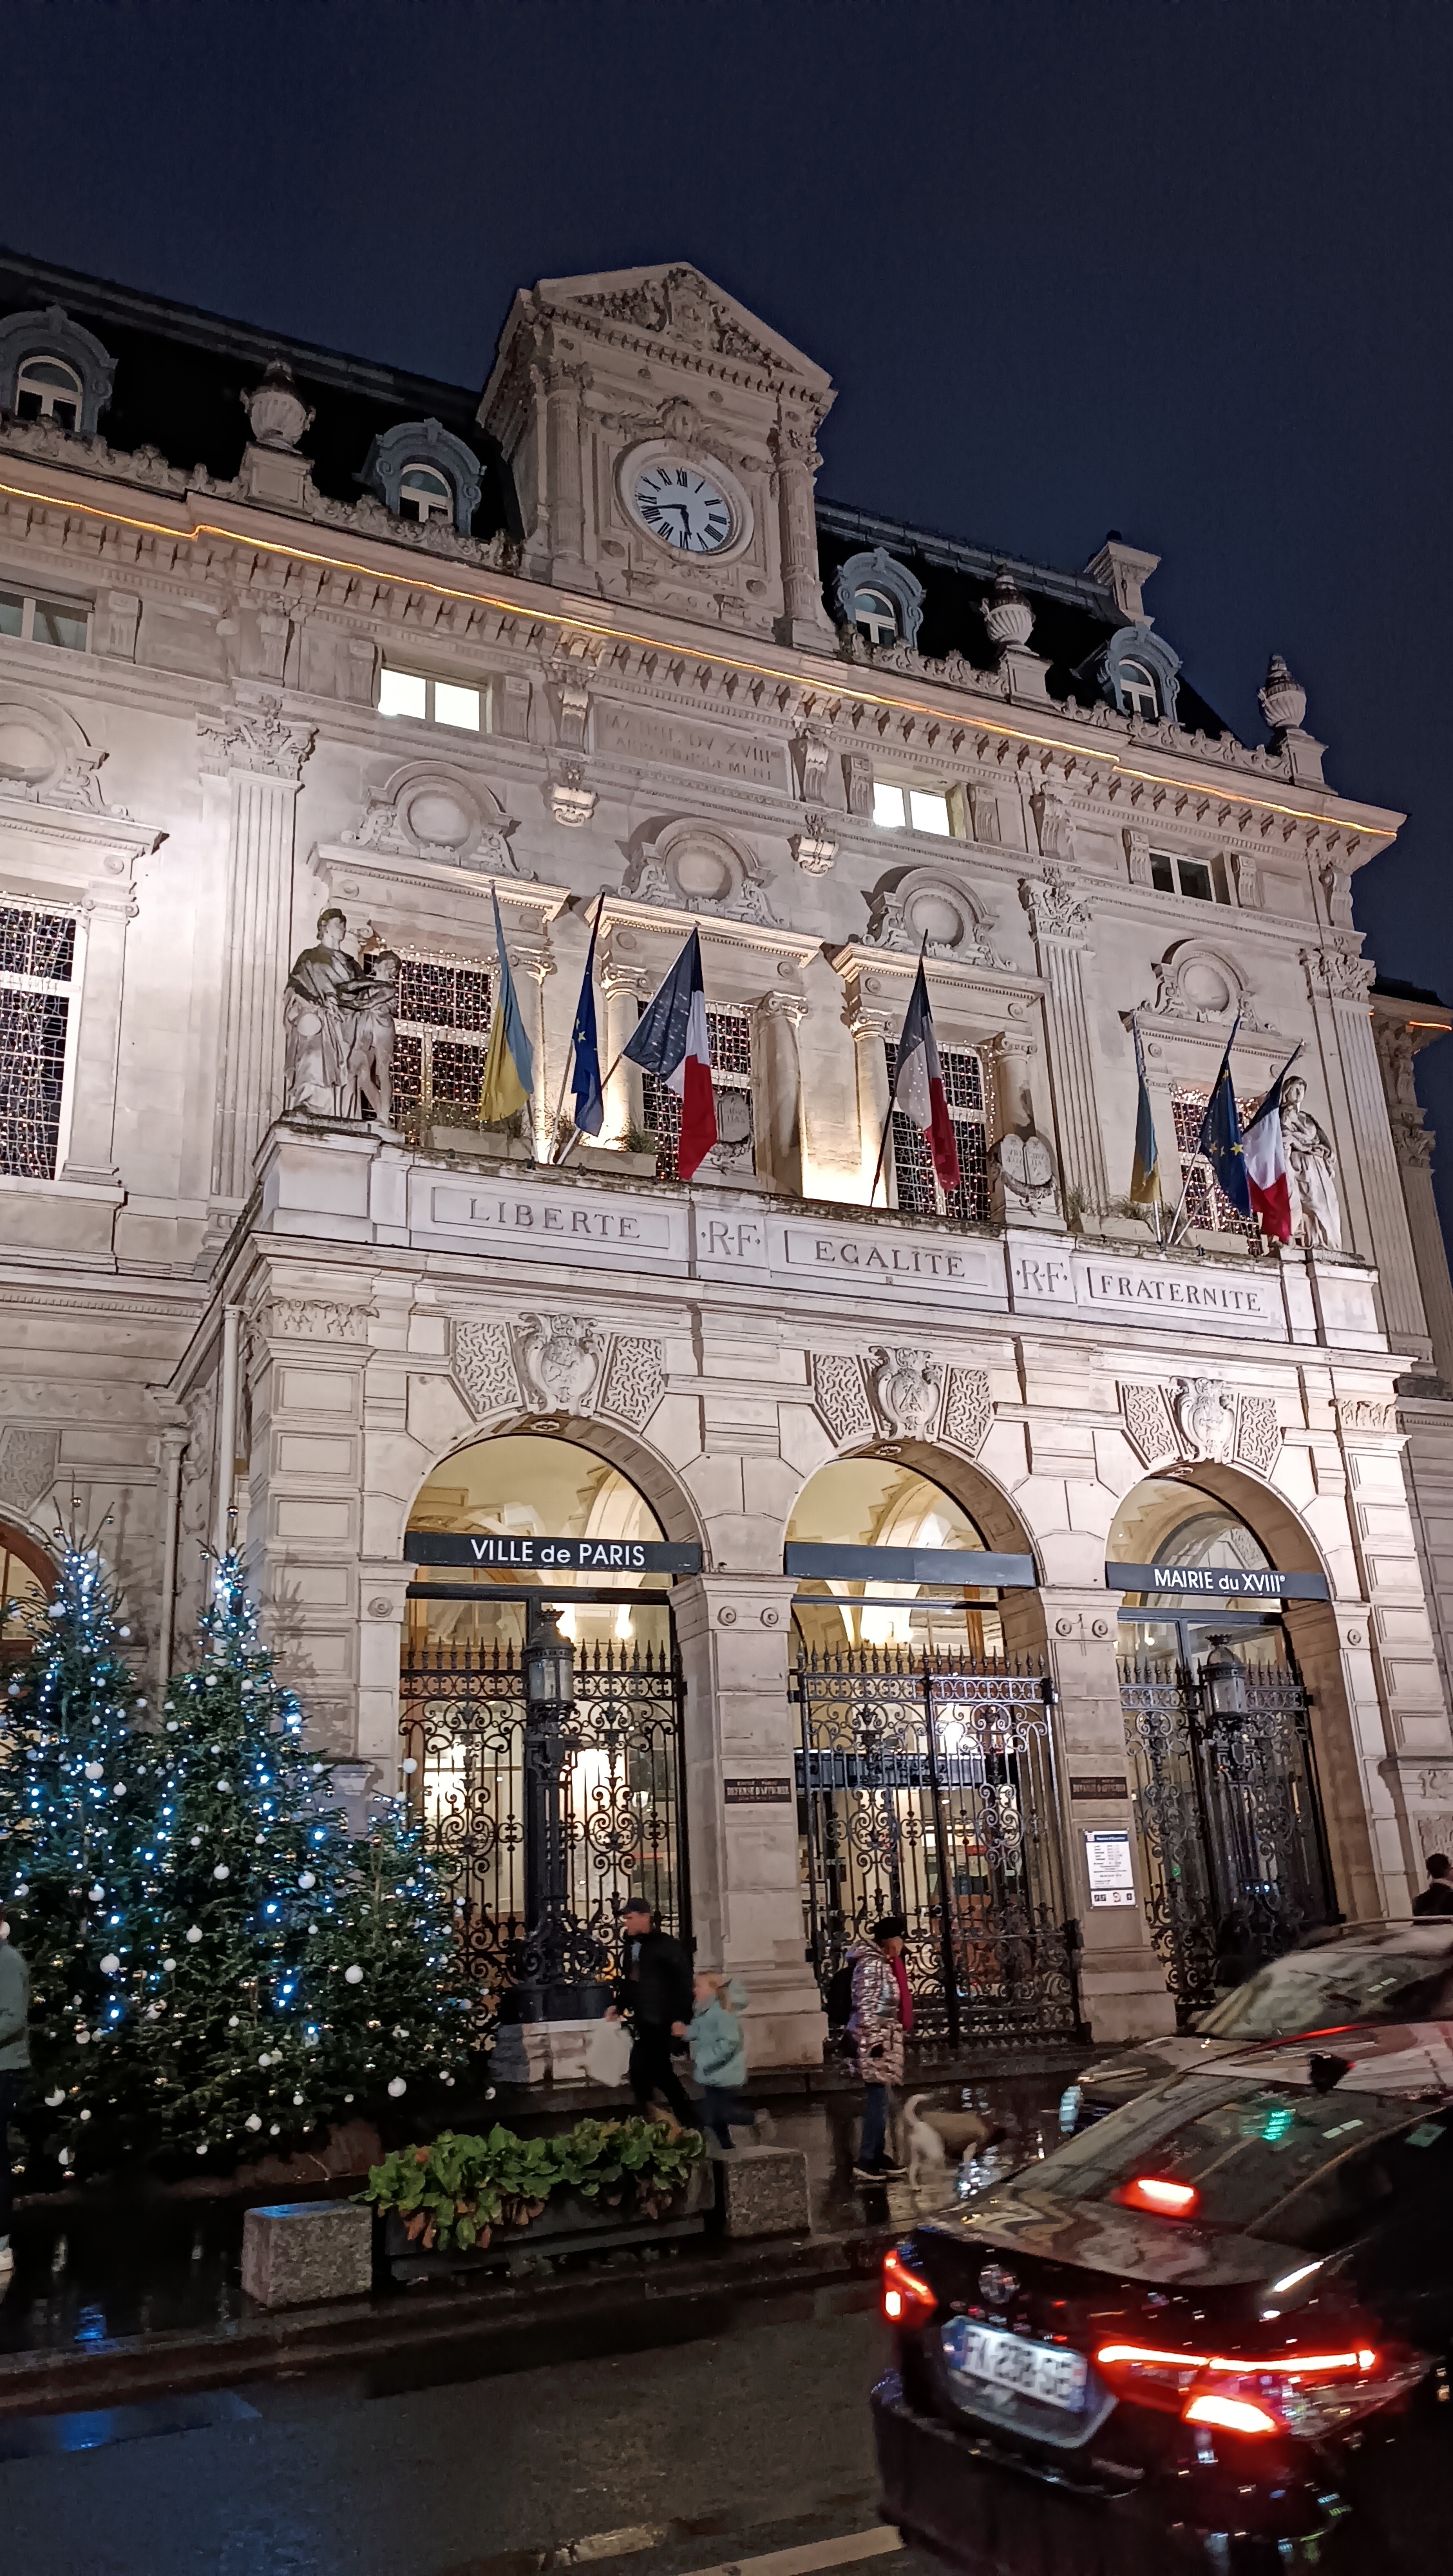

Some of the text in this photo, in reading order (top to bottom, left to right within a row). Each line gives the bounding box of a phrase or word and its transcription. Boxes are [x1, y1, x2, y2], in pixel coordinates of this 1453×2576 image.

[470, 1198, 640, 1238] LIBERTE
[815, 1240, 965, 1277] EGALITE
[1101, 1275, 1261, 1311] FRATERNITE
[470, 1539, 645, 1566] VILLE de PARIS
[1154, 1568, 1214, 1589] MAIRIE
[1219, 1575, 1239, 1591] du
